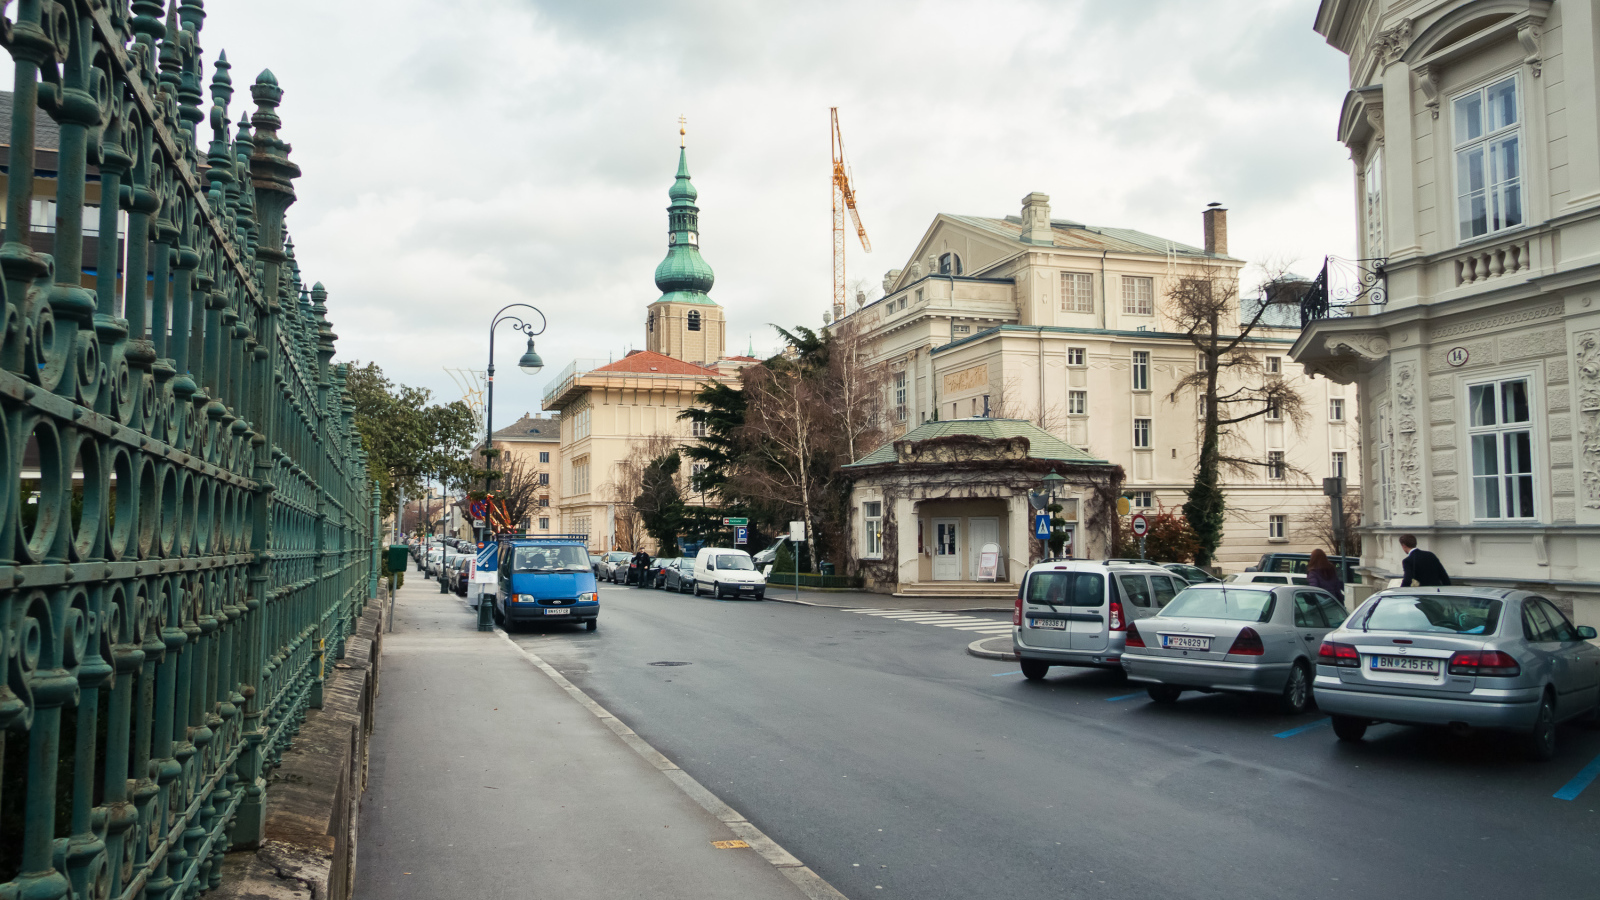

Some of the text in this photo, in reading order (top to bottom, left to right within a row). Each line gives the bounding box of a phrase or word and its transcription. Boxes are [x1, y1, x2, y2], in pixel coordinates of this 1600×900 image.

[1453, 350, 1462, 361] 14
[739, 529, 745, 538] P
[1168, 637, 1174, 645] W
[1178, 638, 1201, 647] 24829
[1380, 657, 1434, 670] BN 215 FR
